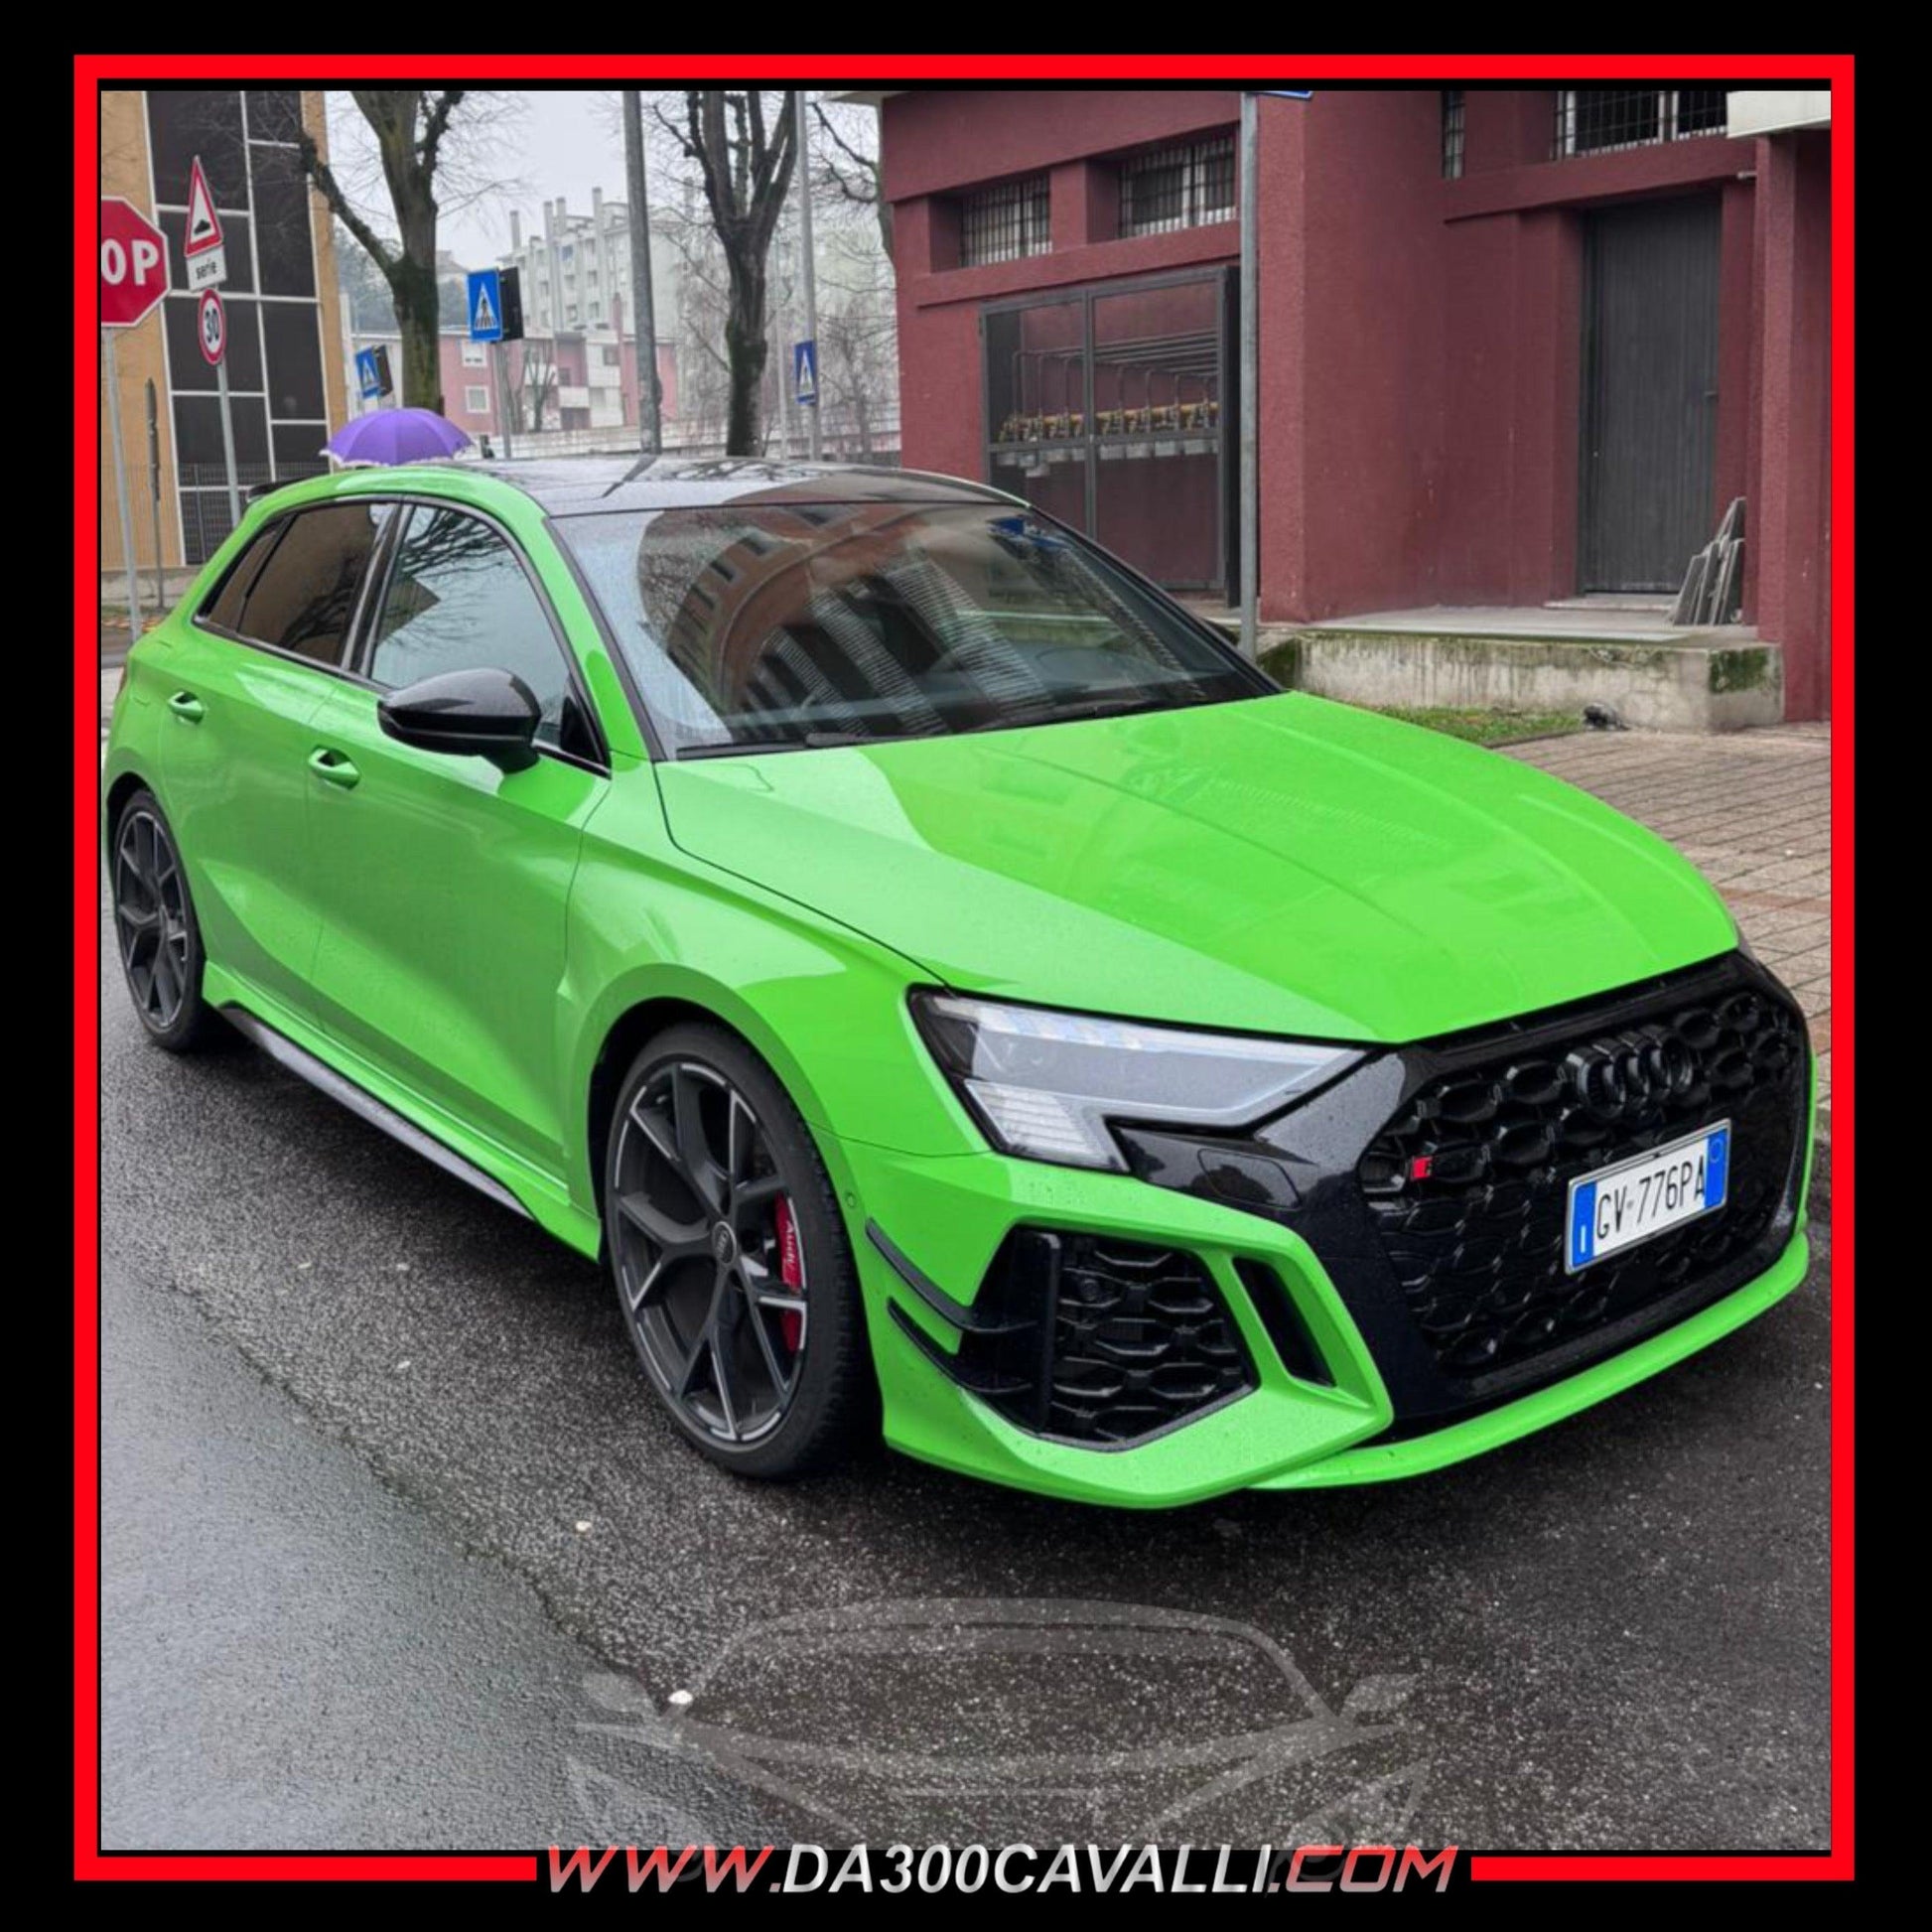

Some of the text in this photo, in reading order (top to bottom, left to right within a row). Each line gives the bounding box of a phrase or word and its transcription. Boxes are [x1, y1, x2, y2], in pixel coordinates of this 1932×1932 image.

[101, 238, 159, 285] OP
[196, 259, 217, 280] serie
[205, 308, 219, 344] 30
